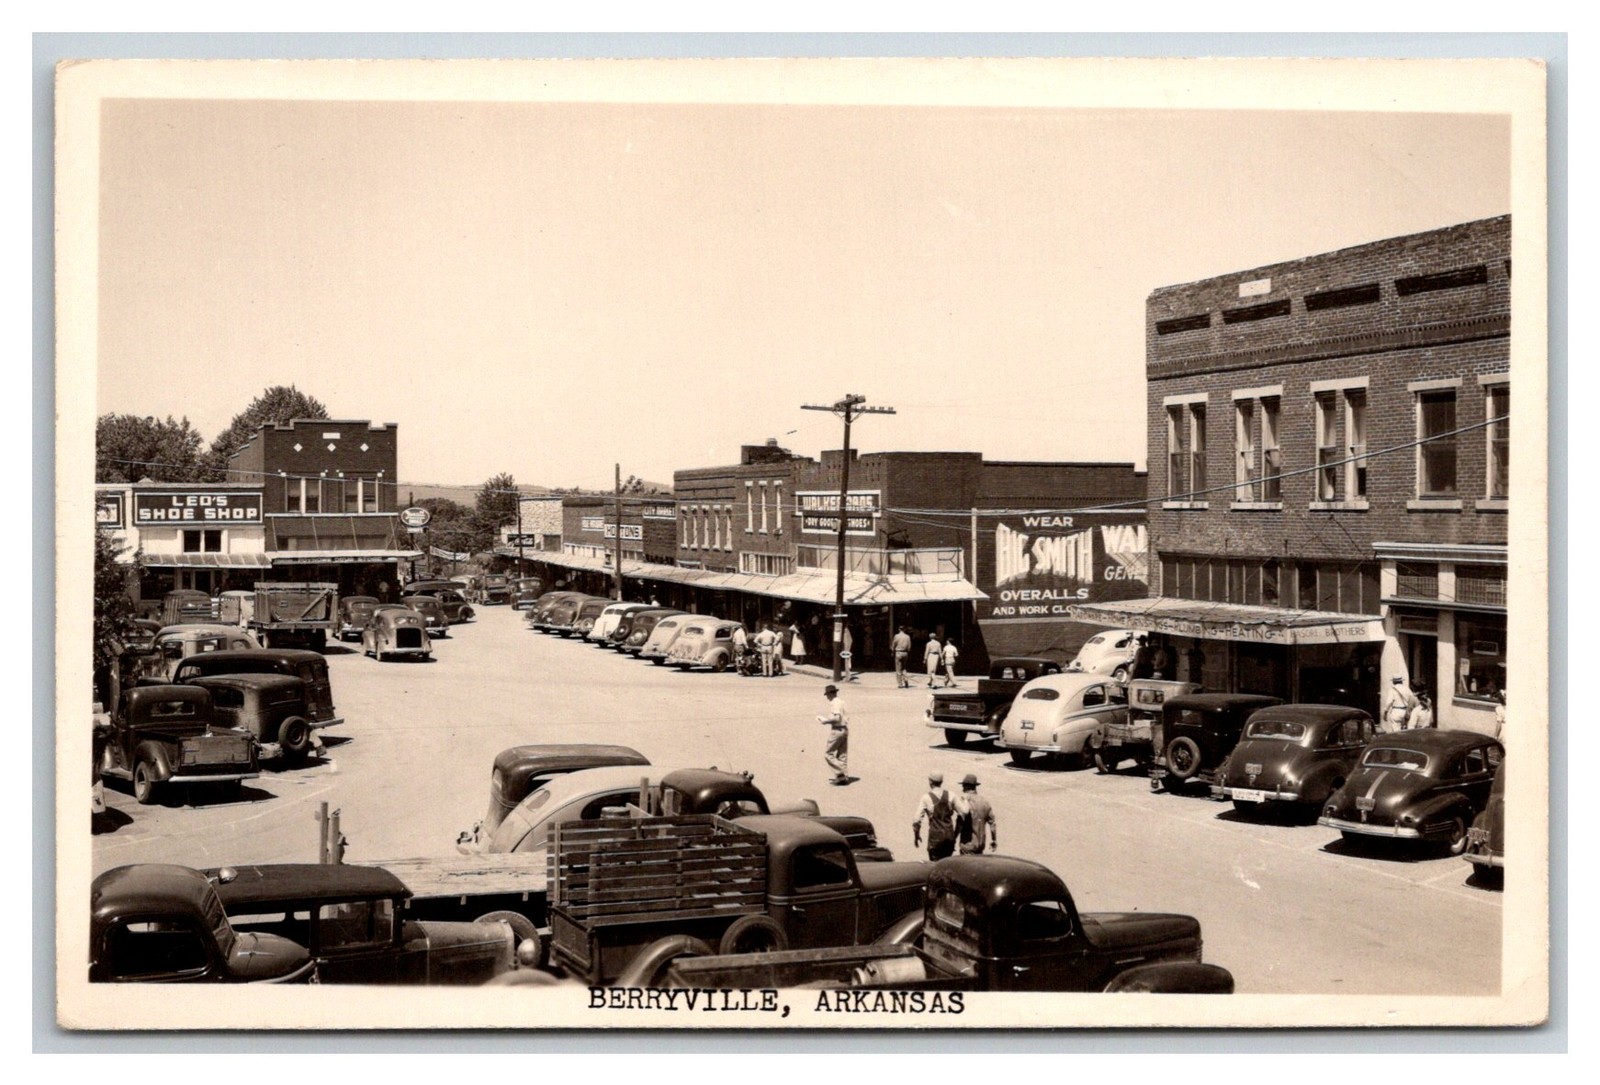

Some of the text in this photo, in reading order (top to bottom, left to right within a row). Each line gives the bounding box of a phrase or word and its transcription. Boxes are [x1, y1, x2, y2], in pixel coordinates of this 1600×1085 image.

[172, 496, 228, 507] LEO'S
[139, 508, 258, 520] SHOE SHOP
[819, 517, 841, 528] GOO
[1022, 516, 1074, 527] WEAR
[605, 525, 640, 538] HOTONS
[995, 522, 1094, 588] BIG SMITH
[1000, 588, 1090, 601] OVERALLS
[993, 605, 1016, 616] AND
[1019, 605, 1048, 615] WORK
[949, 704, 967, 712] DODGE
